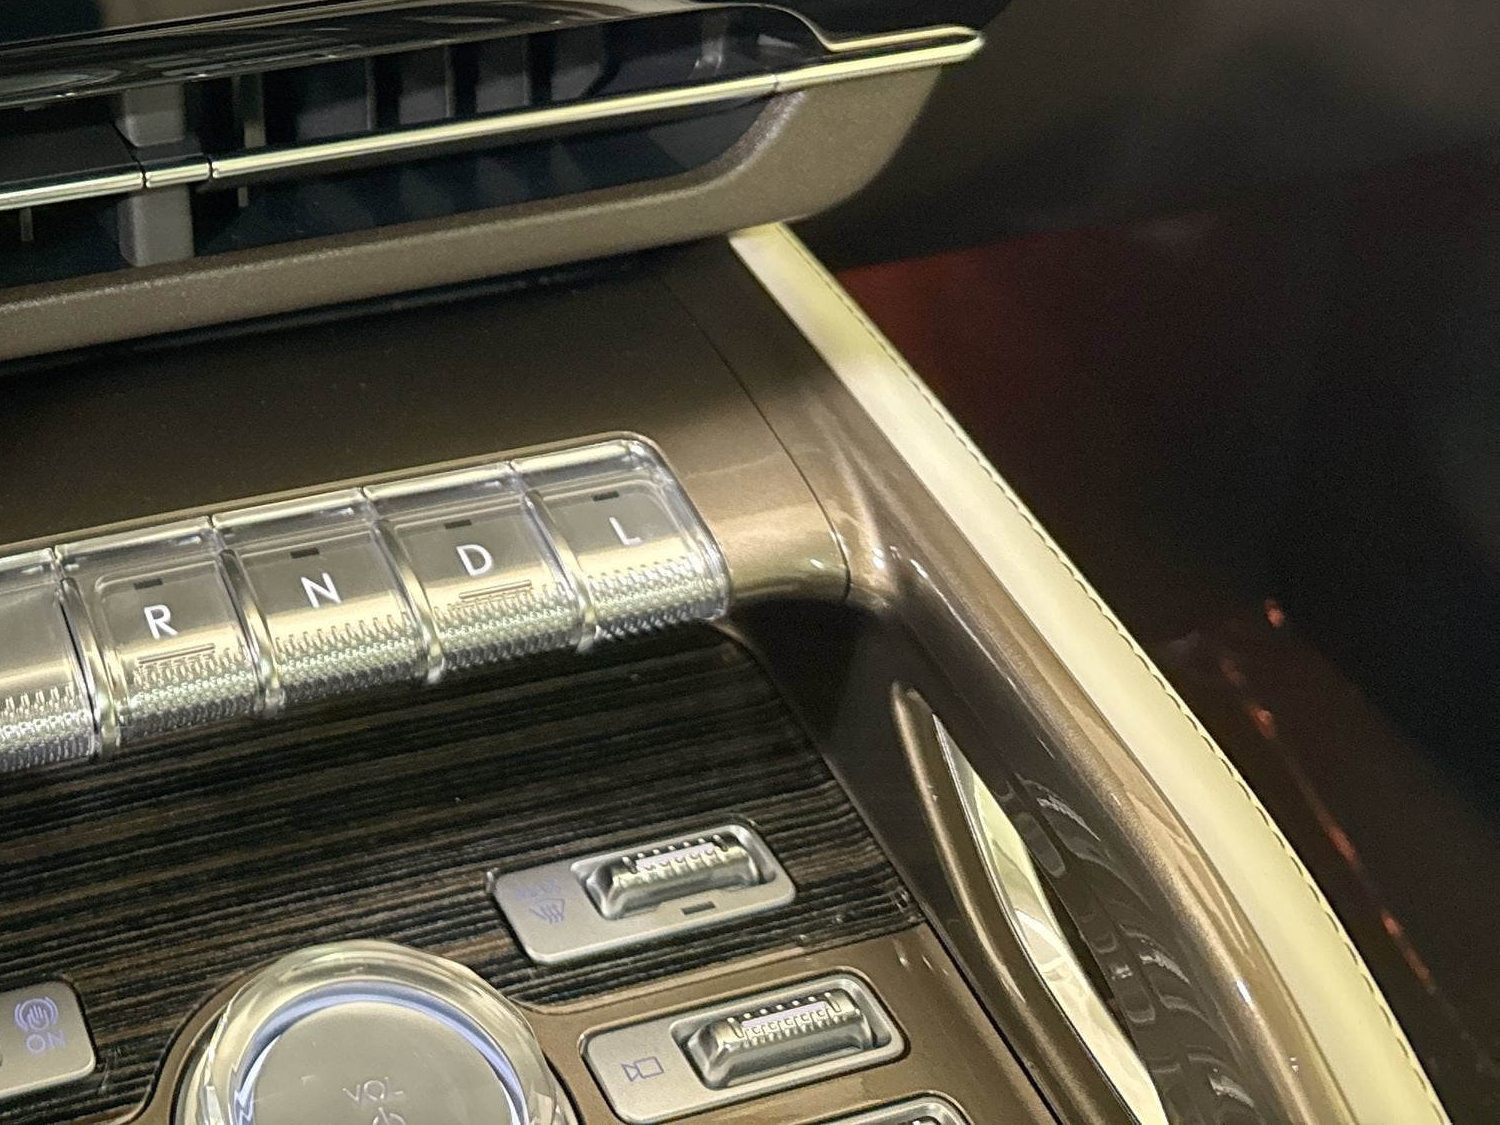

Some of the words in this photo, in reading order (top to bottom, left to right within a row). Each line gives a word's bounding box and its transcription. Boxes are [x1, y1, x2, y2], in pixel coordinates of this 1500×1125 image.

[608, 516, 643, 546] L
[456, 543, 494, 577] D
[301, 572, 342, 609] N
[142, 604, 179, 640] R
[26, 1030, 66, 1053] ON
[342, 1077, 404, 1104] VOL
